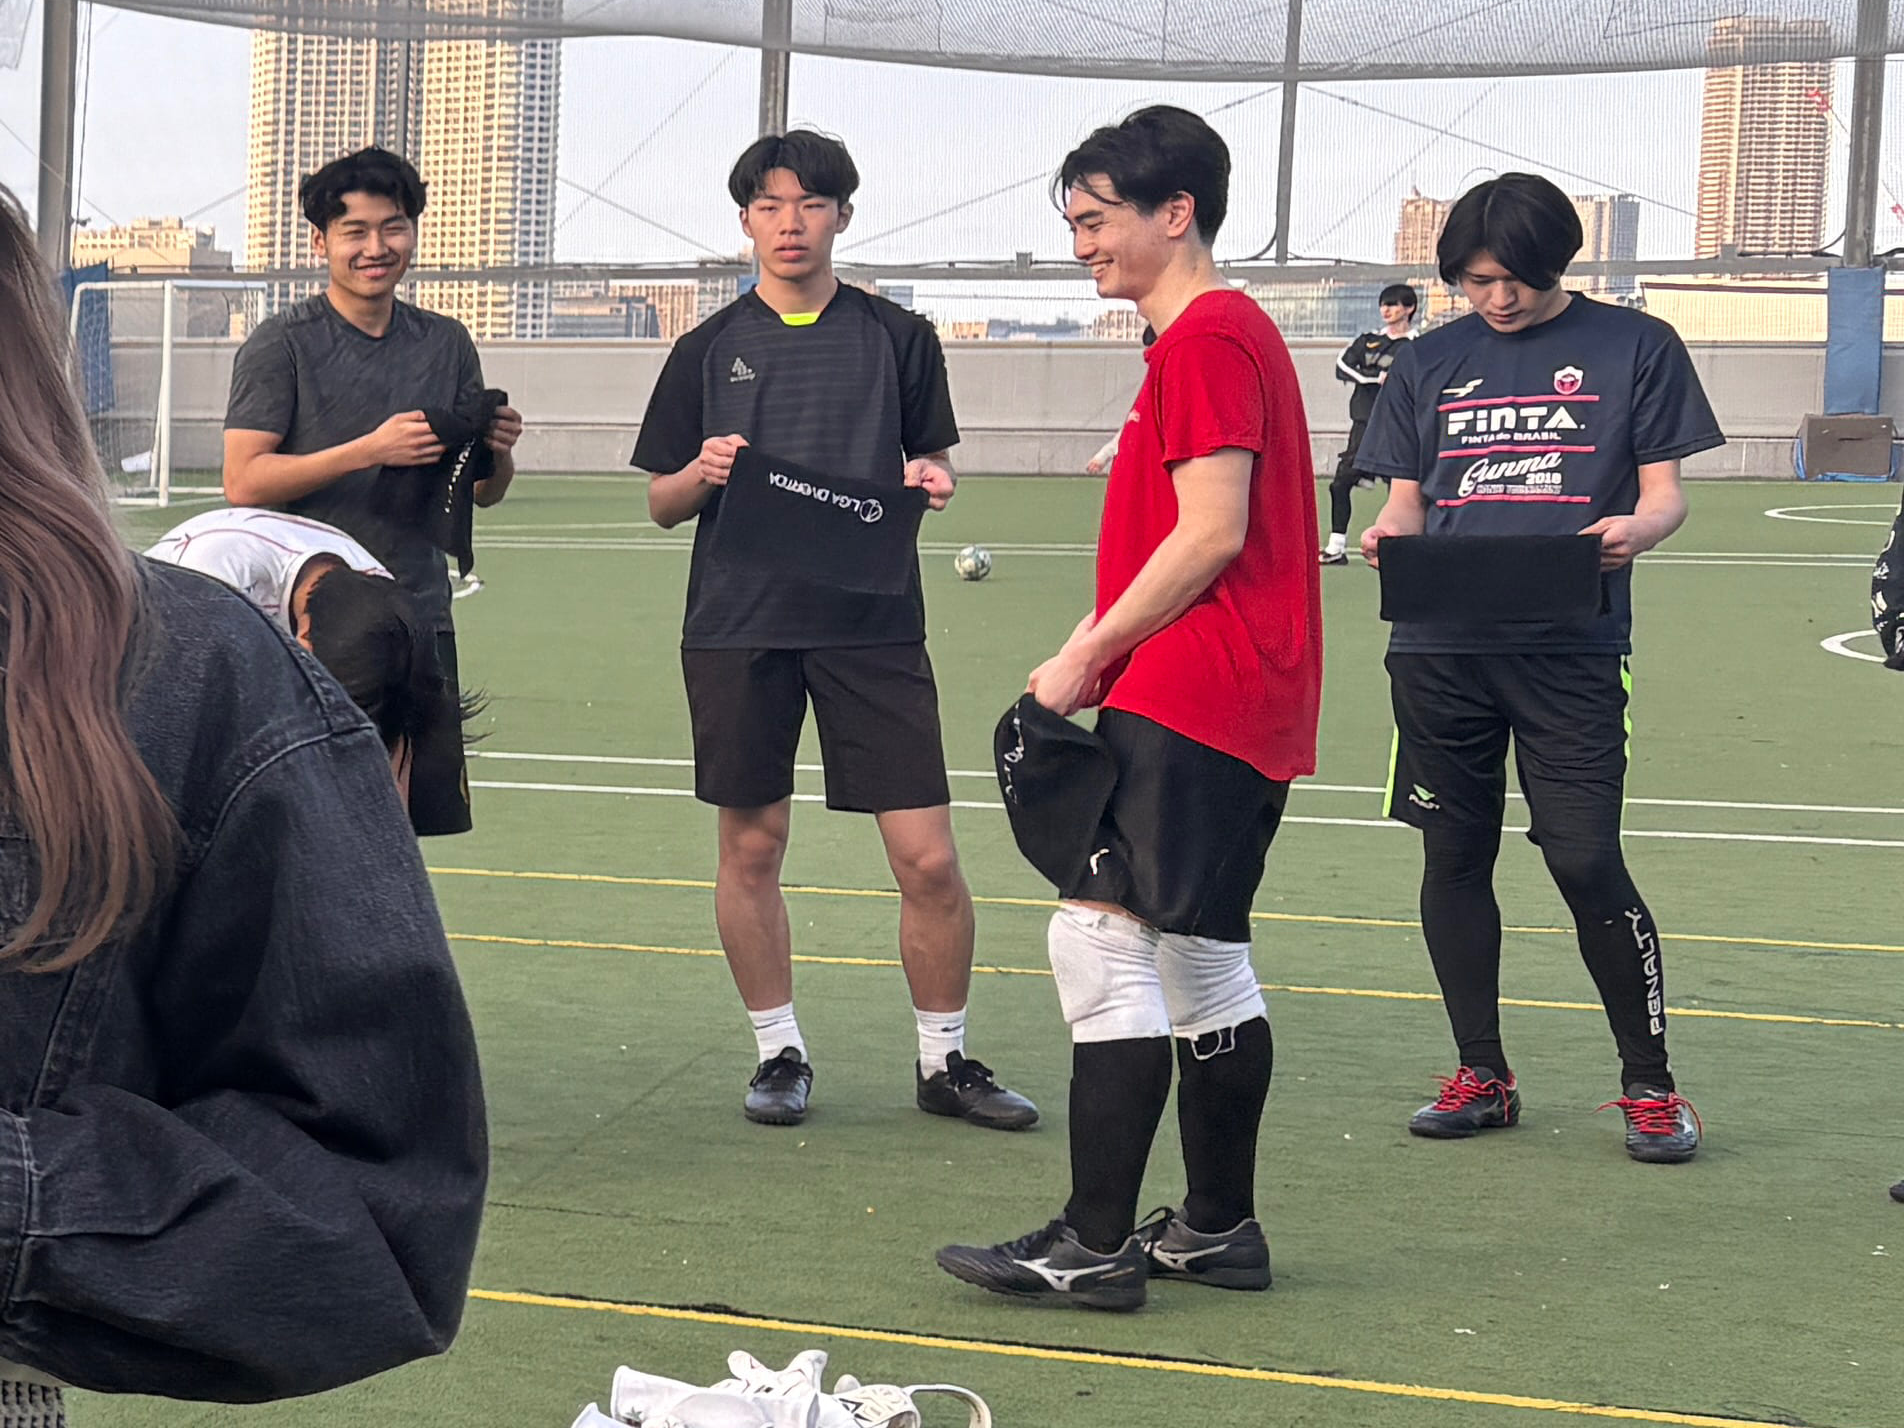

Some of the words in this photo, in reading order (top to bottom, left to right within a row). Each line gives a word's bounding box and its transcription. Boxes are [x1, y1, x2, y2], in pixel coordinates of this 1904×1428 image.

[1461, 434, 1495, 445] FINTA
[1513, 432, 1562, 441] BRASIL
[1457, 451, 1563, 498] Gunma
[1624, 908, 1664, 1036] PENALTY
